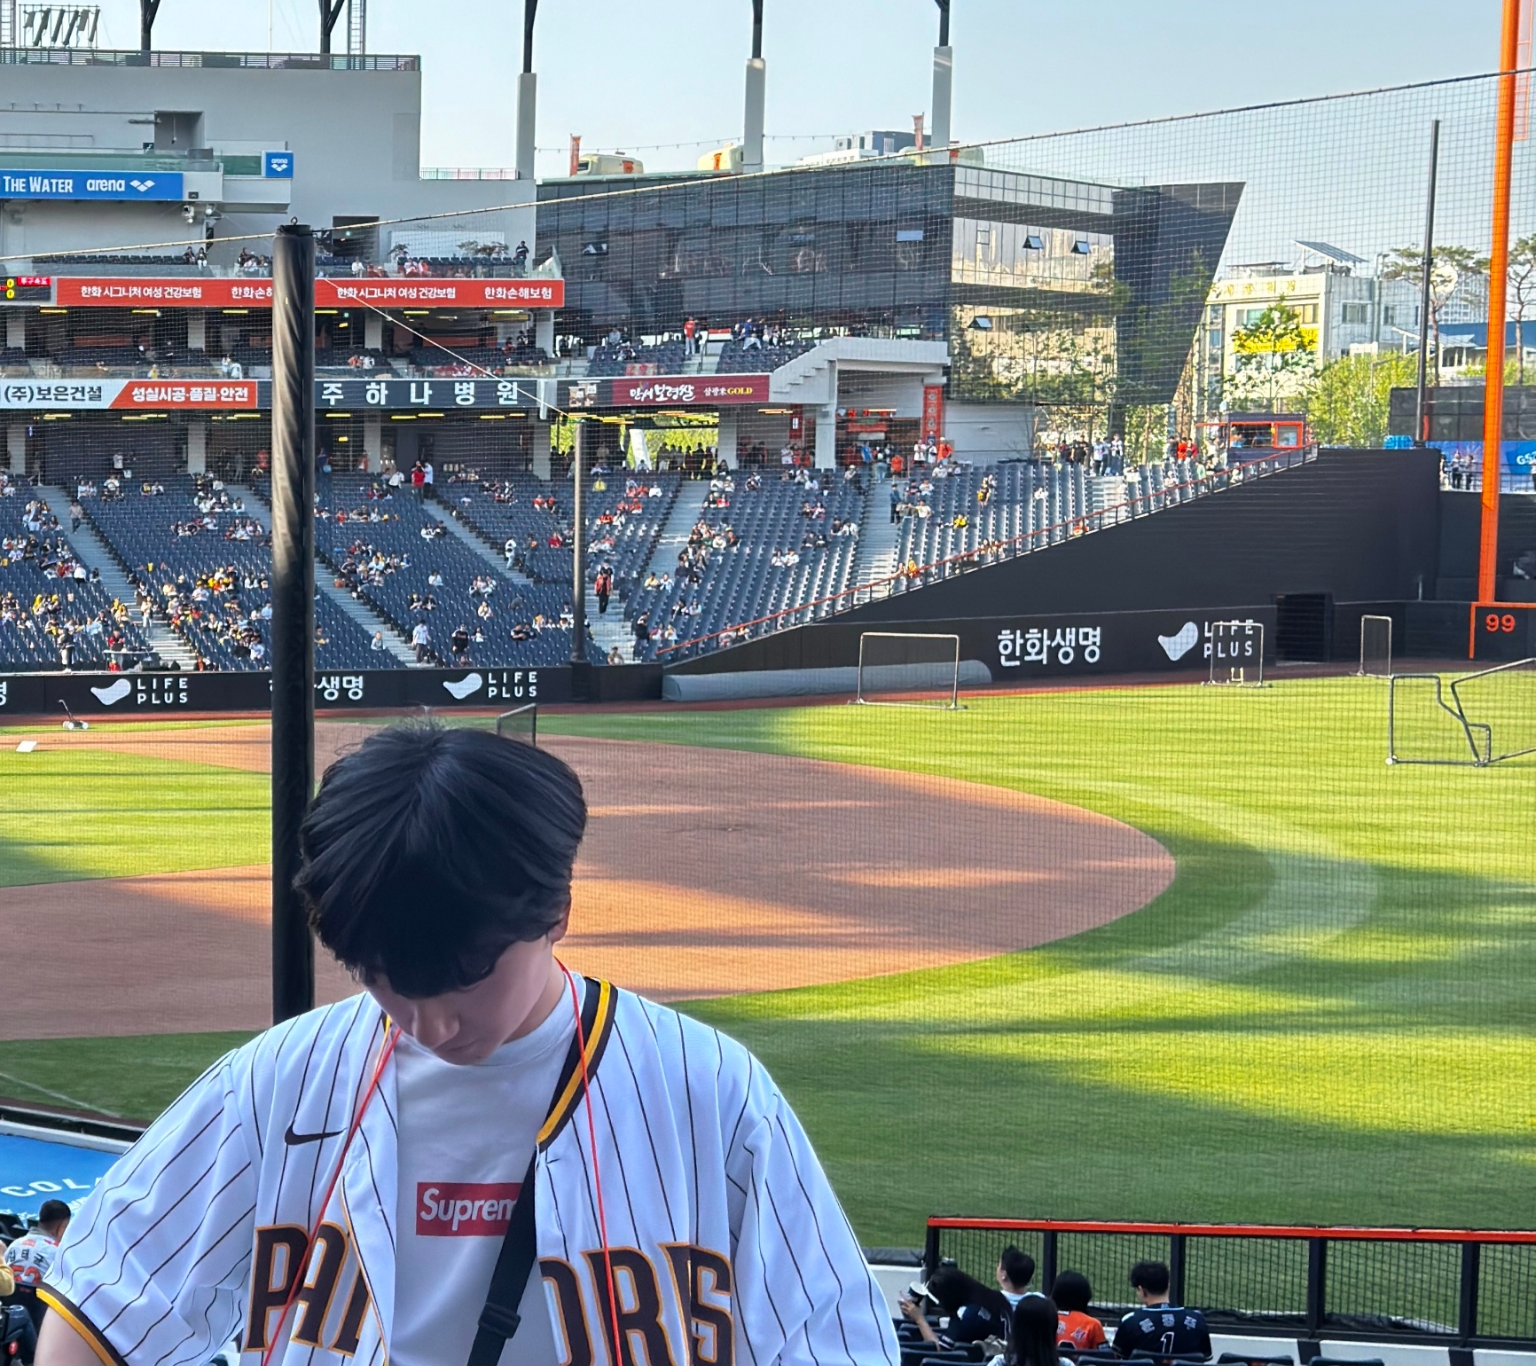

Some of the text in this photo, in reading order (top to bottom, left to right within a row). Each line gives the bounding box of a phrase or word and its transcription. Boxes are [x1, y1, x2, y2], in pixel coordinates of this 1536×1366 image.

[86, 179, 125, 192] arena
[81, 287, 202, 299] 한화 시그니처 여성 건강보험
[337, 288, 456, 299] 한화 시그니처 여성 건강보험
[484, 287, 552, 299] 한화손해보험
[4, 385, 103, 403] (주)보은건설
[727, 387, 753, 395] GOLD
[1203, 619, 1255, 636] LIFE
[1484, 614, 1517, 633] 99
[997, 626, 1102, 667] 한화생명
[1203, 641, 1255, 659] PLUS
[138, 678, 188, 690] LIFE
[488, 672, 537, 684] LIFE
[138, 692, 188, 705] PLUS
[488, 686, 537, 698] PLUS
[419, 1187, 515, 1233] Suprem
